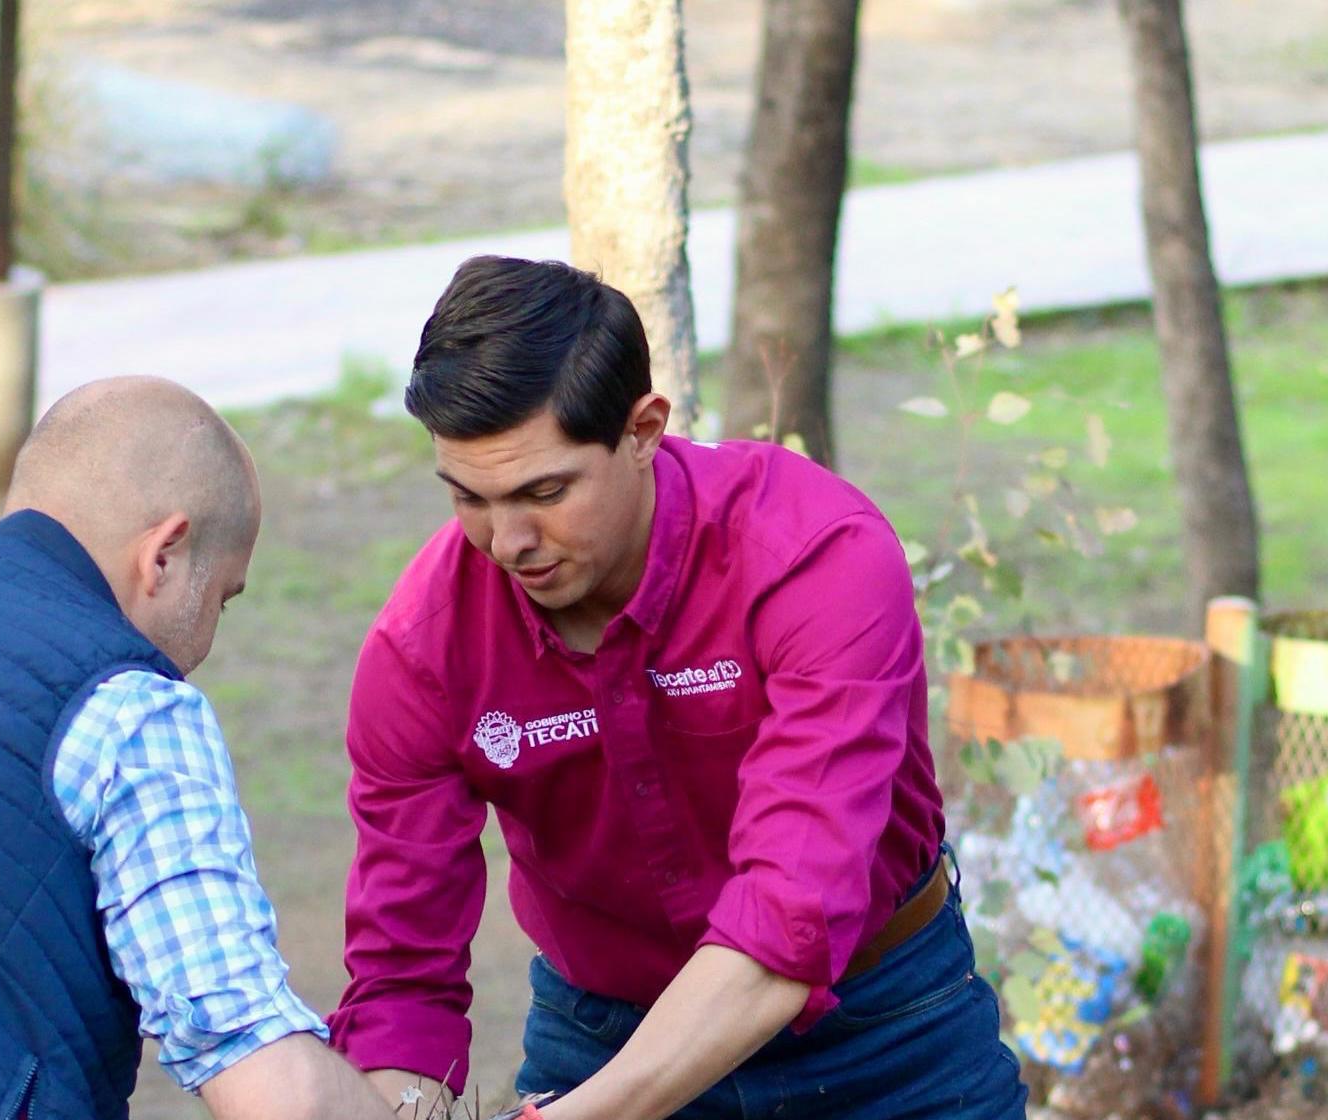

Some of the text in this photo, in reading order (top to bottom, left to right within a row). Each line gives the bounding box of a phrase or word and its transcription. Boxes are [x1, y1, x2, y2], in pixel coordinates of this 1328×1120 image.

[645, 667, 708, 688] Tecate
[681, 680, 736, 697] AYUNTAMIENTO
[525, 711, 582, 731] GOBIERNO
